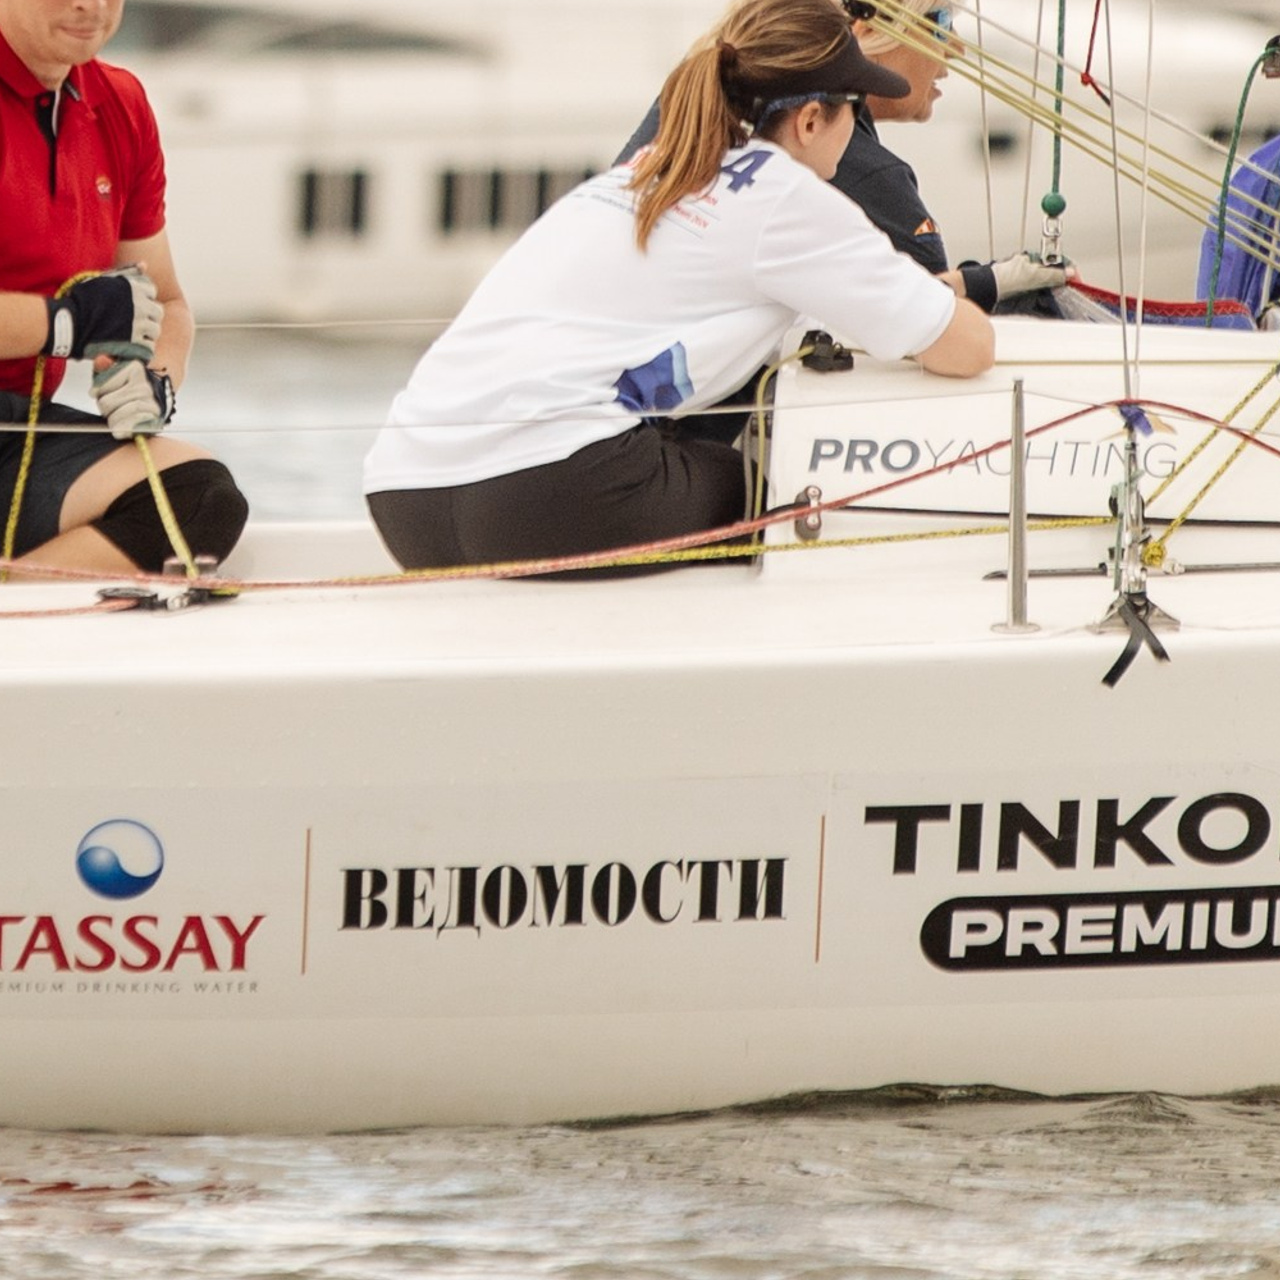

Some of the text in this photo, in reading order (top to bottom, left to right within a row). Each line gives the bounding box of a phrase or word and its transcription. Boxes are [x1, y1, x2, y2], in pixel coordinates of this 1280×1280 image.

[864, 792, 1280, 875] TINKO
[338, 857, 790, 939] ВЕДОМОСТИ
[949, 897, 1280, 959] PREMIU
[76, 981, 181, 995] DRINKING
[193, 981, 260, 995] WATER
